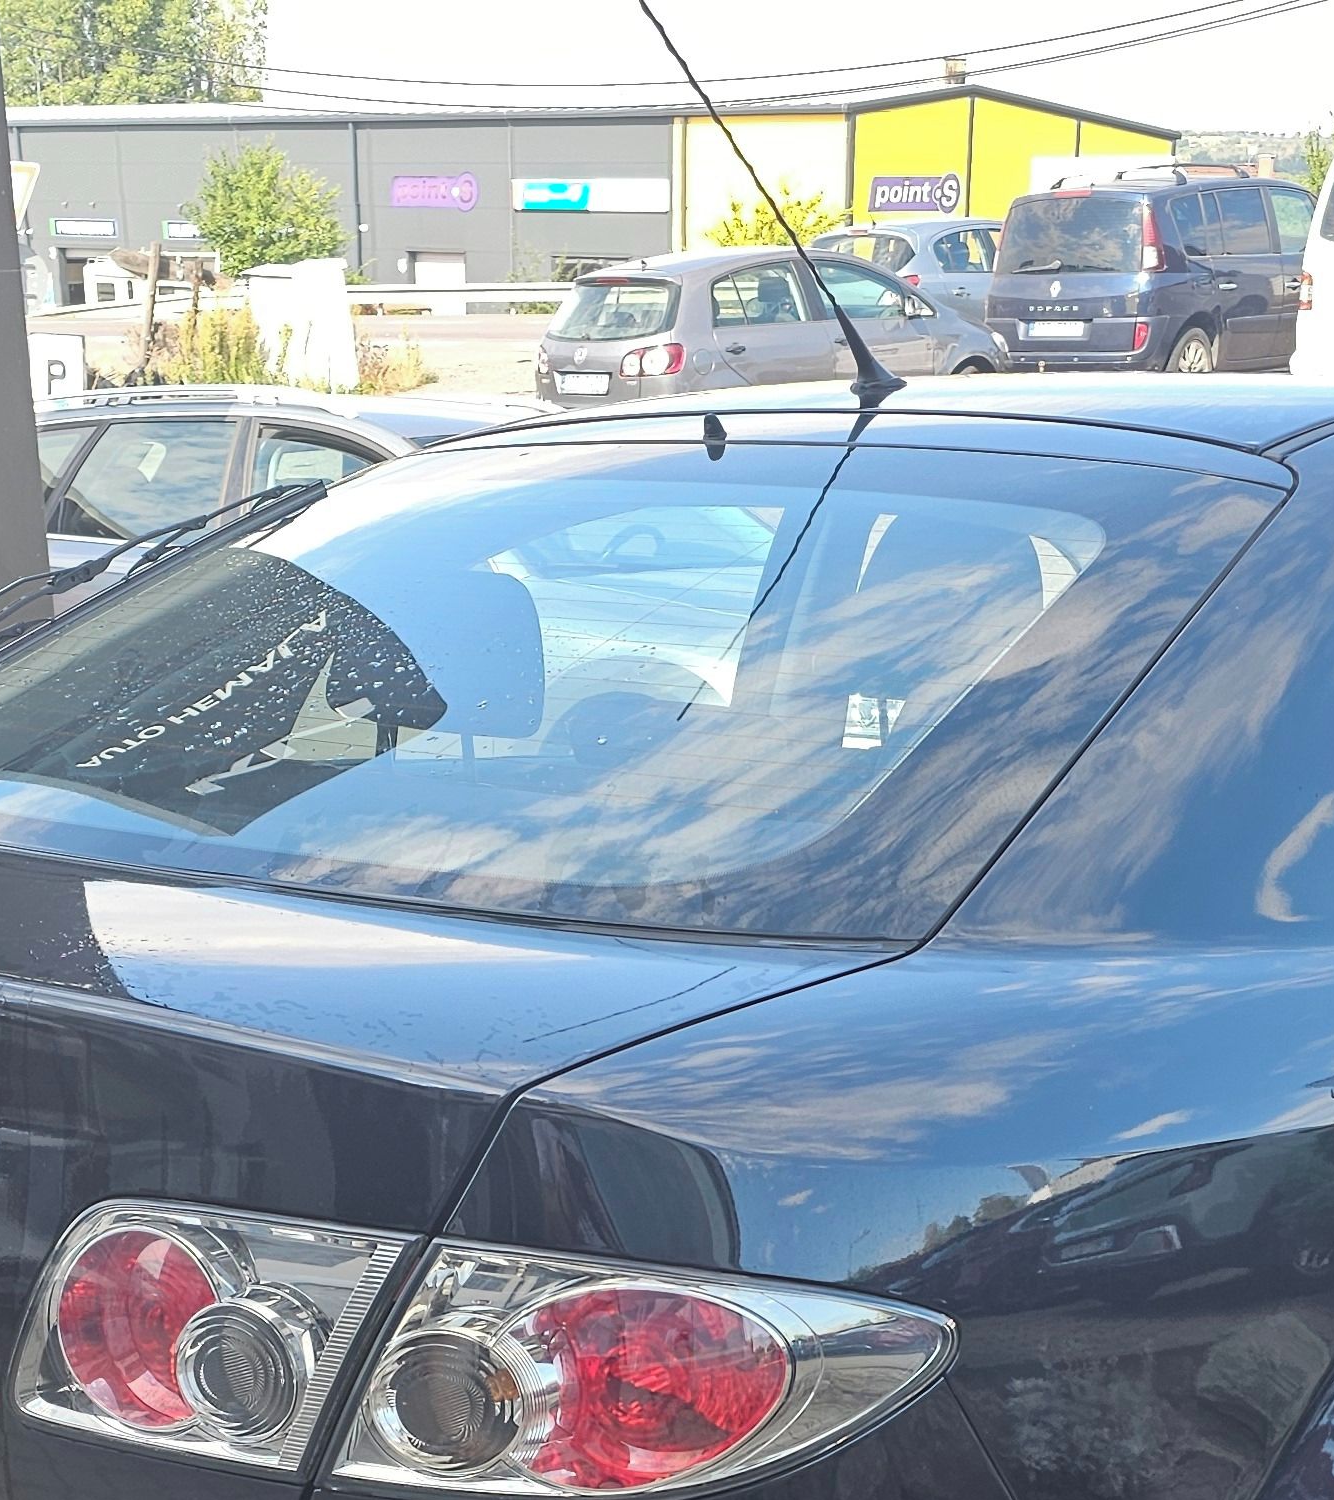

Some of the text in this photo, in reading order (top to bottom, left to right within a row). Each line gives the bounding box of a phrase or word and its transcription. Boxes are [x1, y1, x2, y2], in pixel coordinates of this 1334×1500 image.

[874, 179, 958, 208] point S
[47, 359, 66, 396] P
